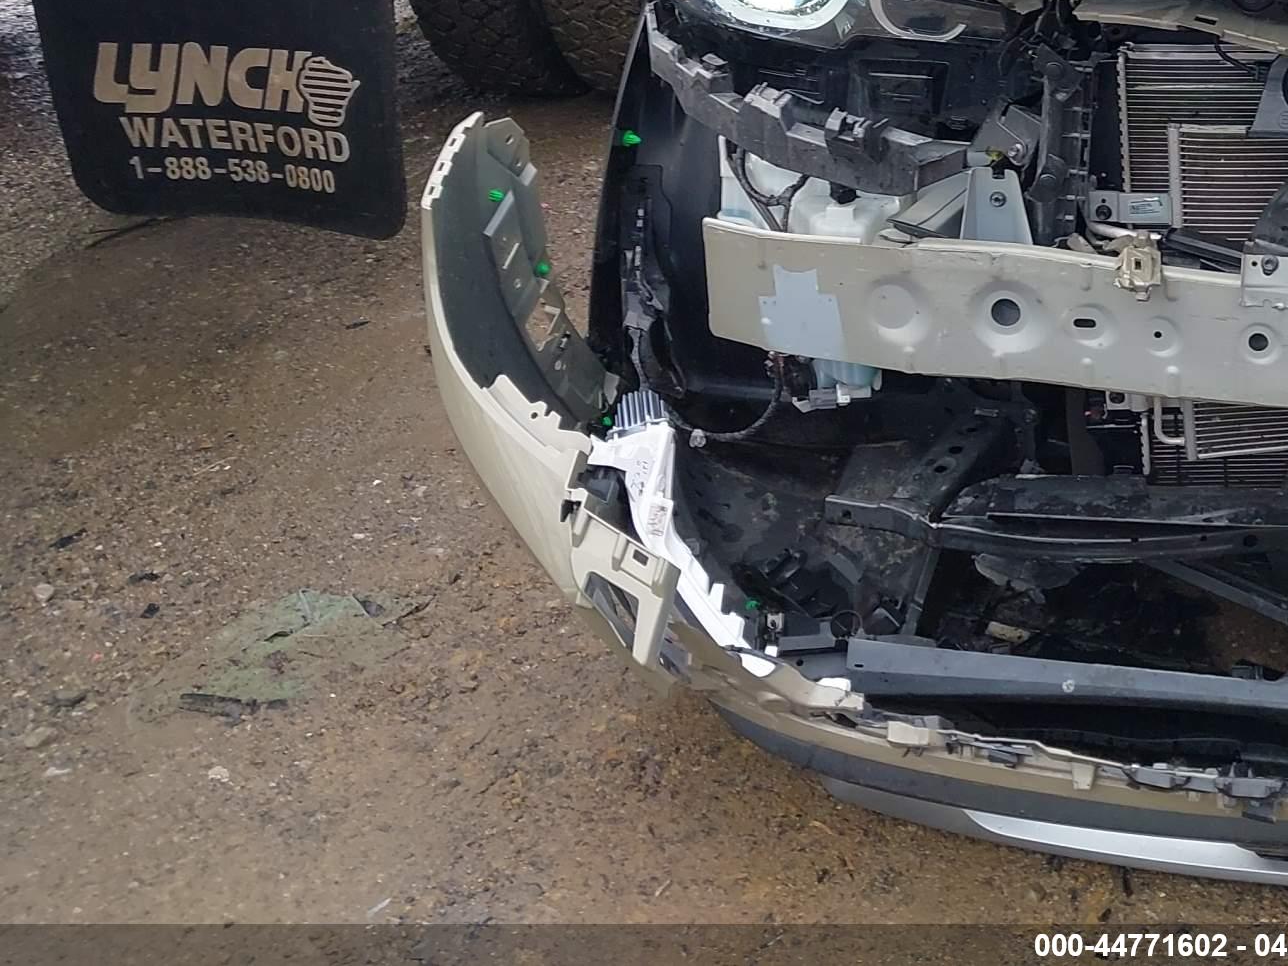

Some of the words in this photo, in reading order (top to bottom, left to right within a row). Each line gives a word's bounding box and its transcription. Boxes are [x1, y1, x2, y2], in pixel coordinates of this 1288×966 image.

[93, 41, 312, 113] LYNCH
[119, 117, 350, 162] WATERFORD
[129, 155, 335, 193] 1-888-538-0800
